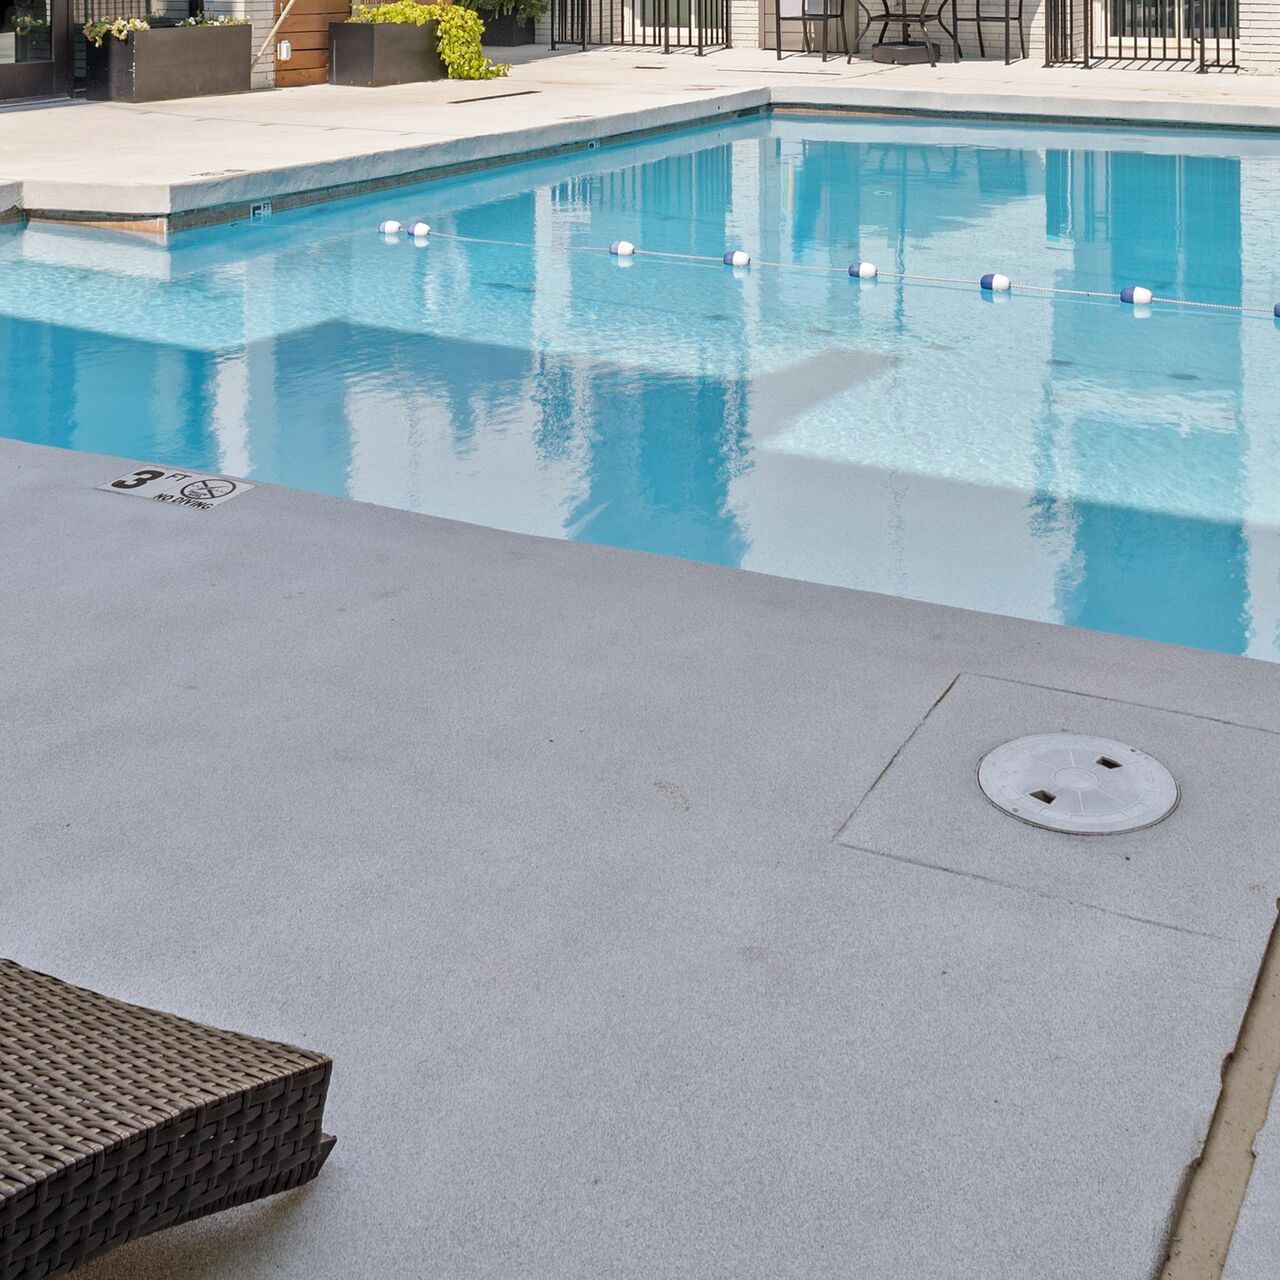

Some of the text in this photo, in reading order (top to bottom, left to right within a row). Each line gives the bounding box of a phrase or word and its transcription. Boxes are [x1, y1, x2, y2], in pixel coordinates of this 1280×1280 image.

[111, 470, 192, 489] 3 FT
[153, 493, 214, 510] NO DIVING
